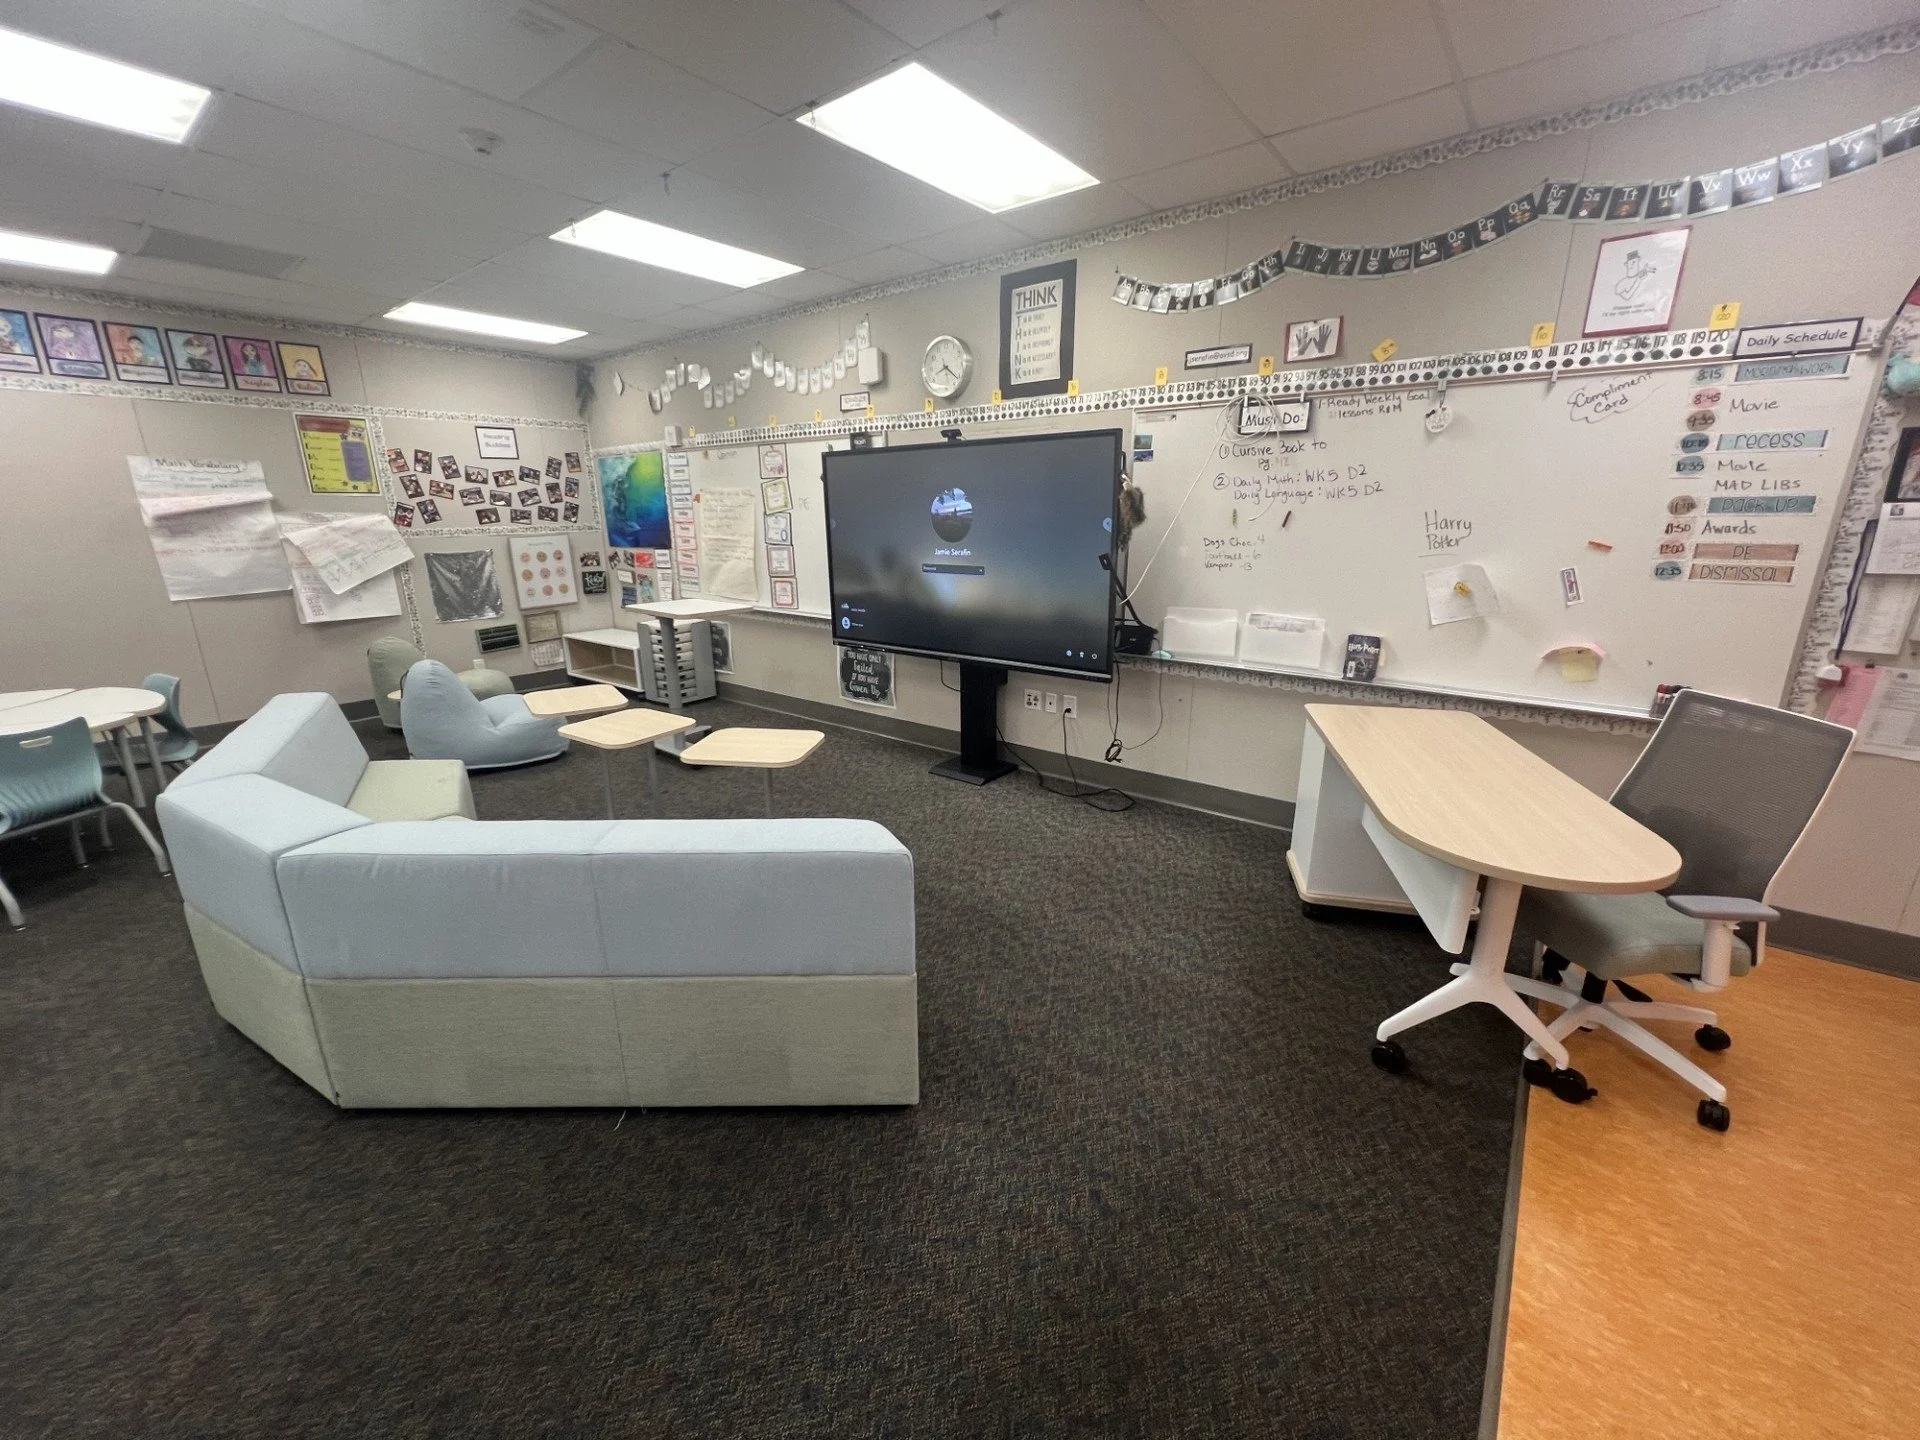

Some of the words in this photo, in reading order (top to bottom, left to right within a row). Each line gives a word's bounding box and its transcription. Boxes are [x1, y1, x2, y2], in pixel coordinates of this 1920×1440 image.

[1550, 186, 1566, 199] Rr
[1584, 187, 1600, 201] Ss
[1622, 188, 1640, 200] Tt
[1658, 186, 1680, 199] Uu
[1700, 178, 1720, 192] Vv
[1738, 170, 1771, 186] Ww
[1790, 156, 1813, 172] Xx
[1840, 140, 1864, 156] Yy
[1339, 250, 1354, 262] Kk
[1388, 247, 1410, 259] Mm
[1420, 240, 1437, 251] Nn
[1448, 230, 1465, 242] Oo
[1478, 218, 1495, 232] Pp
[1016, 286, 1057, 310] THINK
[1746, 335, 1780, 346] Daily
[1784, 329, 1848, 344] Schedule
[1381, 364, 1395, 373] 100
[1398, 363, 1406, 371] 101
[1410, 362, 1422, 370] 102
[1423, 360, 1435, 369] 103
[1453, 357, 1466, 365] 105
[1468, 355, 1481, 364] 106
[1483, 354, 1495, 363] 107
[1499, 352, 1512, 362] 108
[1514, 351, 1527, 360] 109
[1532, 349, 1542, 358] 110
[1549, 346, 1558, 356] 111
[1564, 344, 1577, 355] 112
[1581, 342, 1594, 353] 113
[1635, 337, 1649, 349] 116
[1654, 335, 1667, 347] 117
[1673, 333, 1687, 345] 118
[1691, 331, 1706, 344] 119
[1708, 330, 1729, 342] 120
[1698, 368, 1722, 381] 8:15
[1574, 371, 1654, 407] Compliment
[1364, 392, 1402, 404] Weekly
[1594, 397, 1628, 414] Card
[1694, 392, 1721, 404] 8:45
[1730, 398, 1779, 412] Movie
[1282, 412, 1304, 424] Do:
[1338, 408, 1374, 418] lessons
[1232, 443, 1274, 458] Cursive
[1280, 440, 1306, 454] Book
[1312, 440, 1328, 450] to
[1734, 432, 1806, 449] recess
[1233, 477, 1262, 491] Daily
[1348, 464, 1368, 480] D2
[1714, 480, 1752, 492] MAD
[1761, 479, 1801, 490] LIBS
[1234, 490, 1260, 505] Daily
[1364, 481, 1384, 496] D2
[1424, 510, 1472, 538] Harry
[1701, 520, 1757, 534] Awards
[1204, 538, 1224, 549] Dogs
[1426, 534, 1462, 550] Potter
[1732, 545, 1755, 560] PE
